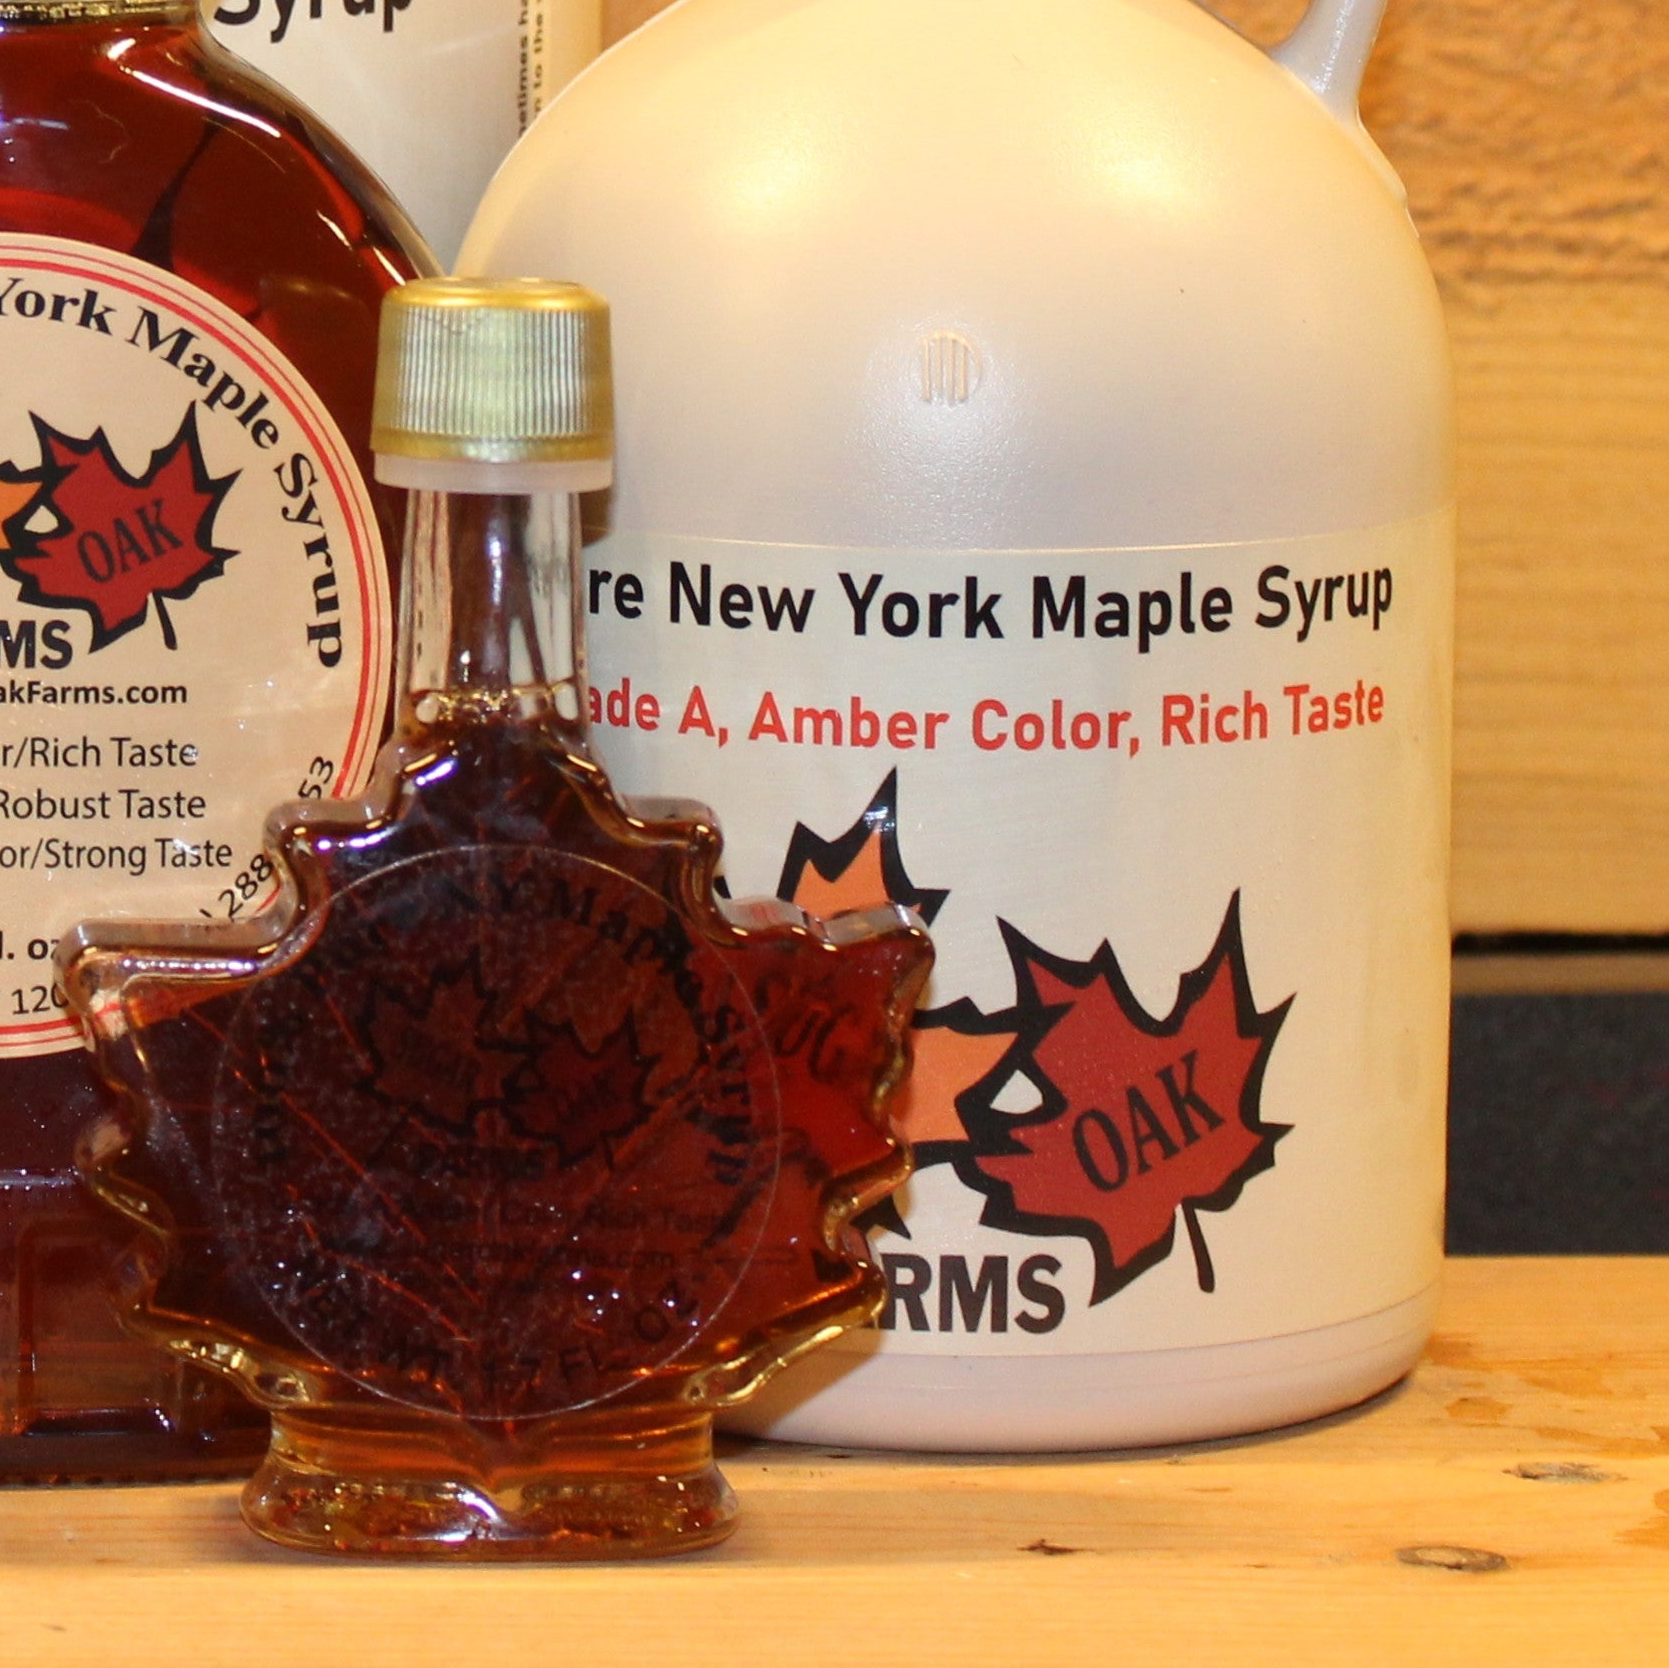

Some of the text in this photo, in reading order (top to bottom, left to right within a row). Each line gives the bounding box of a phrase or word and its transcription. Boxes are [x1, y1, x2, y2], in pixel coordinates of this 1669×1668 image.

[533, 12, 544, 54] the
[126, 305, 282, 451] Maple
[273, 452, 344, 670] Syrup
[76, 498, 186, 585] OAK
[589, 561, 1393, 654] re New York Maple Syrup
[110, 736, 198, 770] Taste
[588, 677, 1386, 760] ade A, Amber Color, Rich Taste
[118, 788, 207, 820] Taste
[154, 838, 232, 868] Taste
[11, 985, 68, 1015] 120
[1073, 1049, 1227, 1194] OAK
[877, 1252, 1066, 1334] RMS
